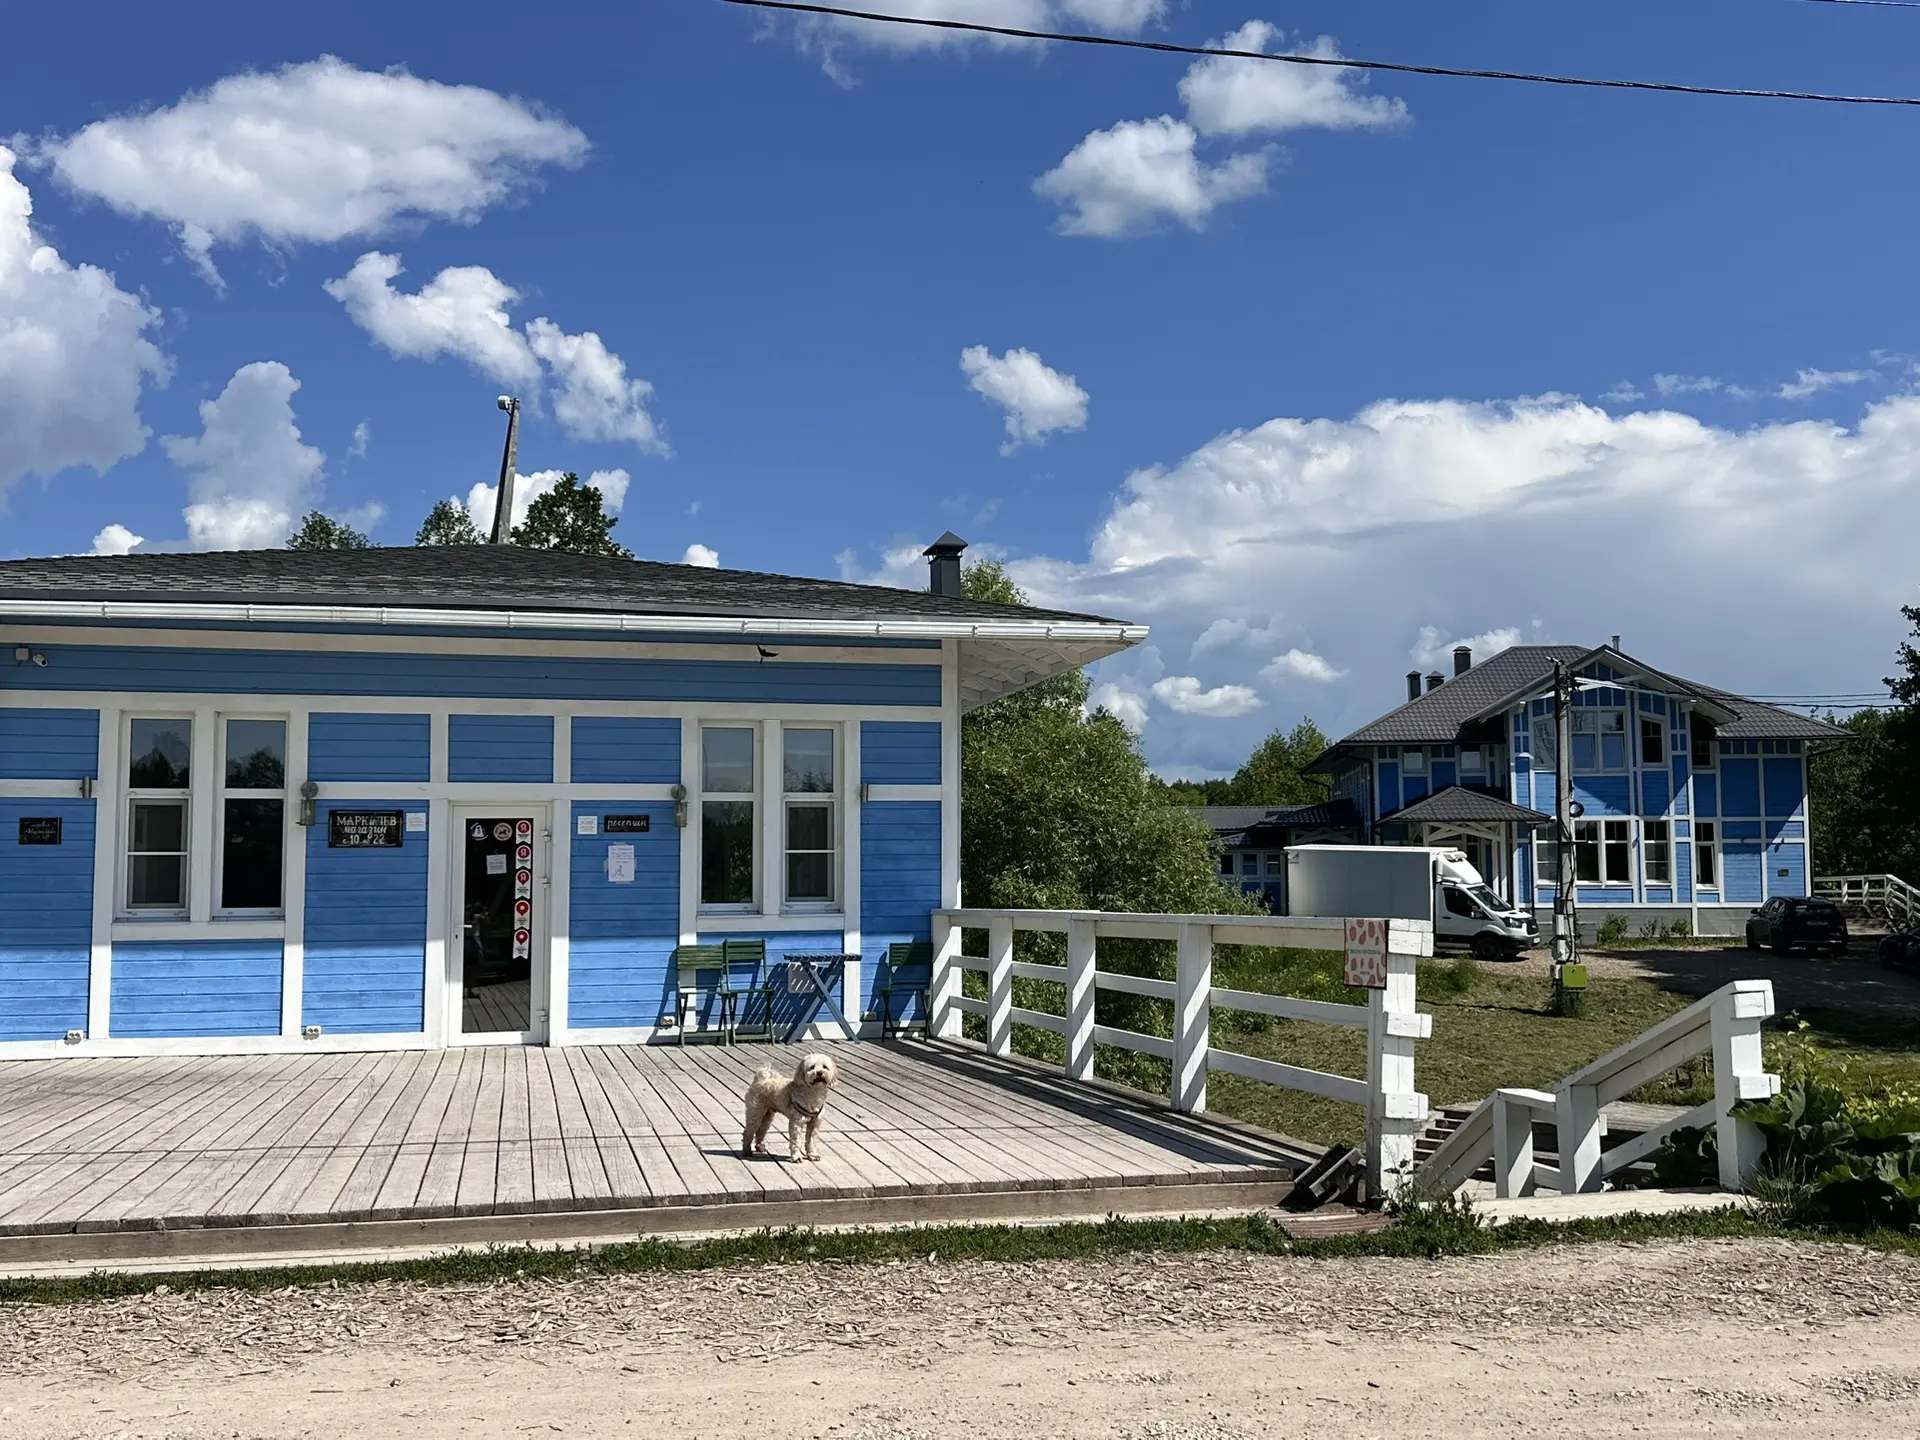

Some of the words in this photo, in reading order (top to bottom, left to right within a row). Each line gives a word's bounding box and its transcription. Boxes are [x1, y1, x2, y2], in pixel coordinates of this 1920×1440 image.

[342, 826, 387, 839] магазин
[350, 834, 360, 844] 10
[373, 834, 386, 844] 22
